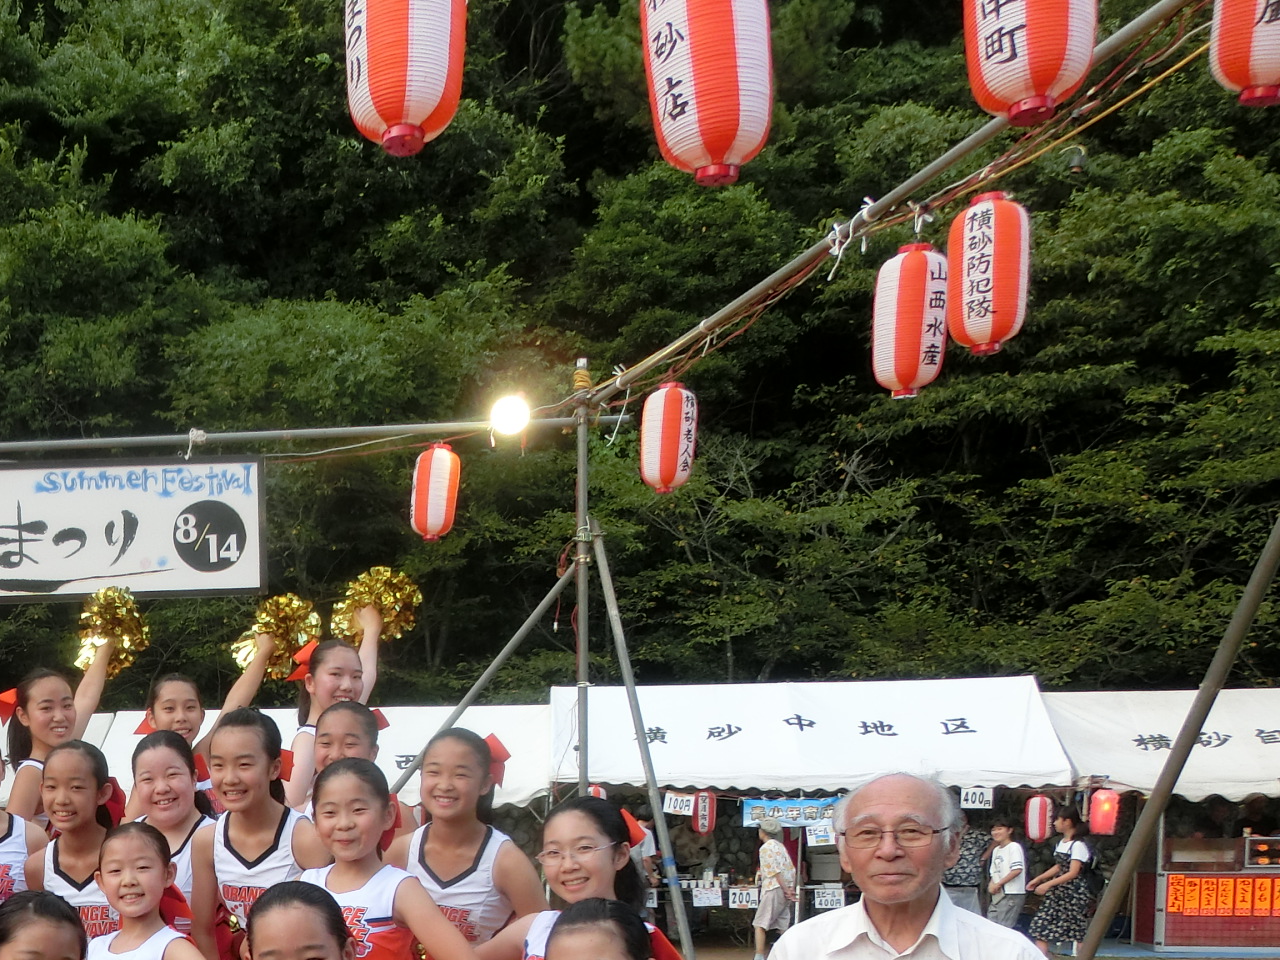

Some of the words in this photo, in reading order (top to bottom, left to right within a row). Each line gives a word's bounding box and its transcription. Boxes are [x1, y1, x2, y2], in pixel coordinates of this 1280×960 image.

[648, 0, 689, 121] 砂店
[965, 208, 998, 321] 横砂防犯隊
[921, 262, 947, 366] 山西水産
[157, 463, 255, 498] Festival
[175, 512, 240, 564] 8/14
[668, 796, 691, 812] 100円
[963, 791, 991, 807] 400円
[731, 892, 758, 906] 200円
